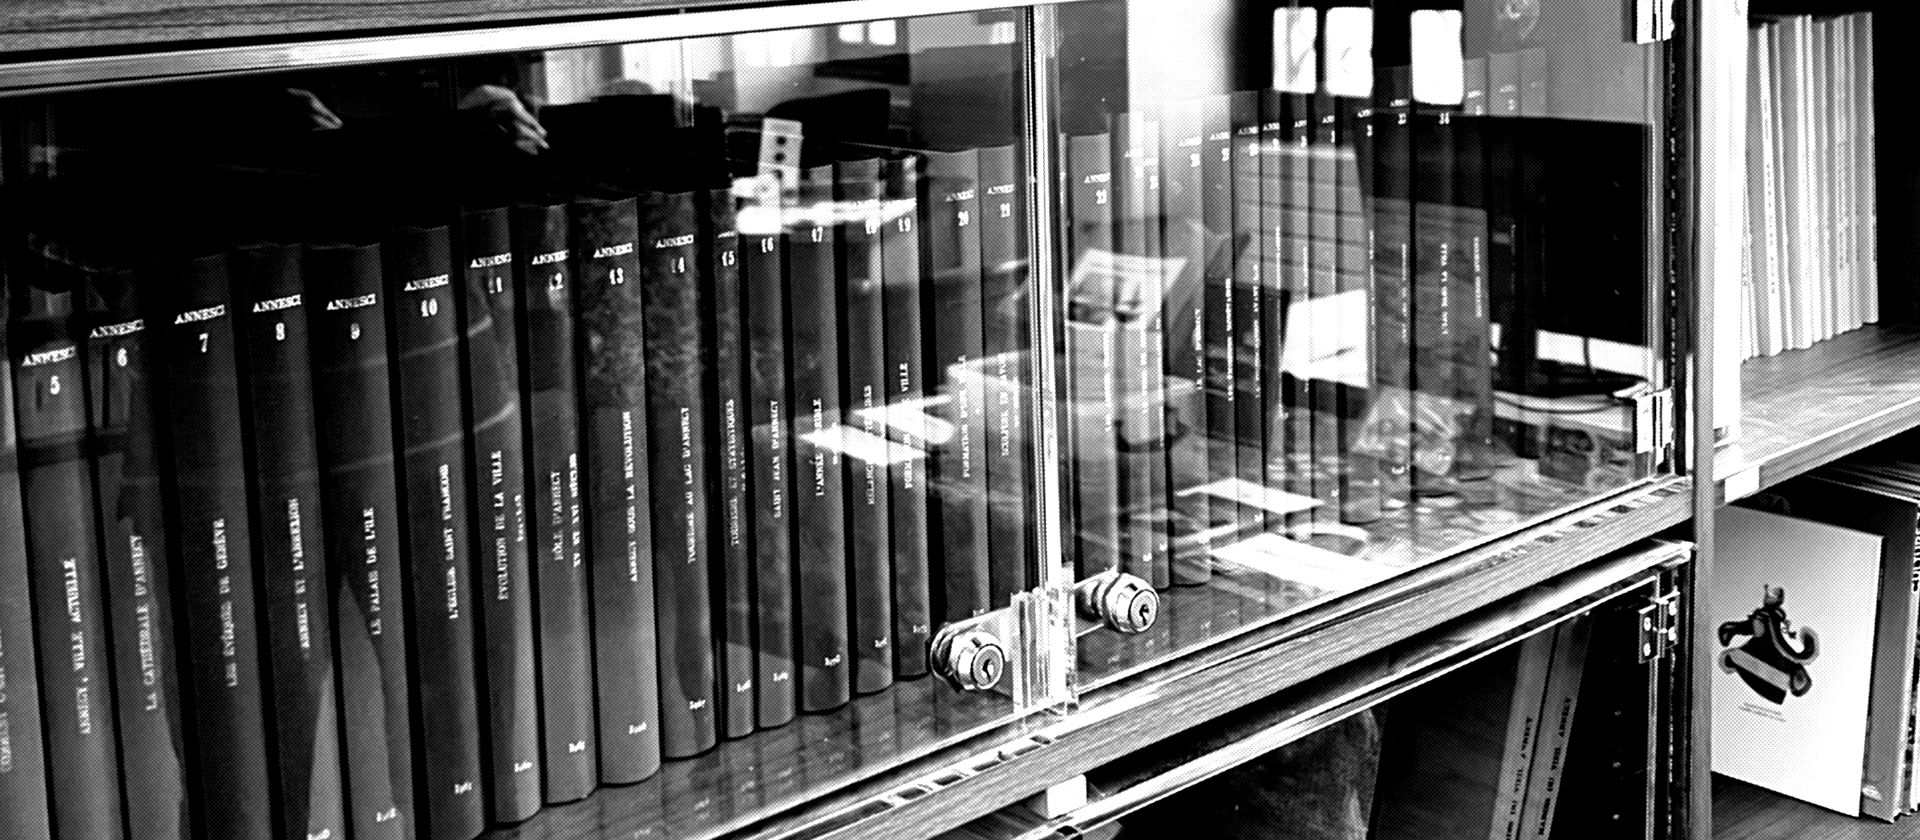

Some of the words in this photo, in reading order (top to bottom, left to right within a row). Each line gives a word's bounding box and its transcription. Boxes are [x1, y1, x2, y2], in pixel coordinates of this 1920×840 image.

[898, 218, 911, 232] 19
[811, 226, 824, 243] 17
[761, 237, 774, 253] 16
[671, 257, 686, 273] 14
[722, 251, 735, 267] 15
[609, 268, 624, 285] 13
[421, 298, 438, 317] 10
[275, 322, 285, 341] 8
[350, 322, 361, 340] 9
[199, 333, 209, 352] 7
[117, 348, 128, 367] 6
[50, 376, 61, 395] 5
[899, 362, 909, 392] VILLE
[491, 450, 503, 485] VILLE
[494, 492, 504, 507] LA
[626, 484, 635, 500] LA
[773, 489, 782, 518] SAINT
[495, 515, 506, 530] DE
[443, 528, 455, 560] SAINT
[366, 546, 377, 564] DE
[220, 576, 230, 594] DE
[368, 570, 381, 612] PALAIS
[371, 618, 382, 635] LE
[72, 631, 85, 671] VILLE
[146, 692, 158, 711] LA
